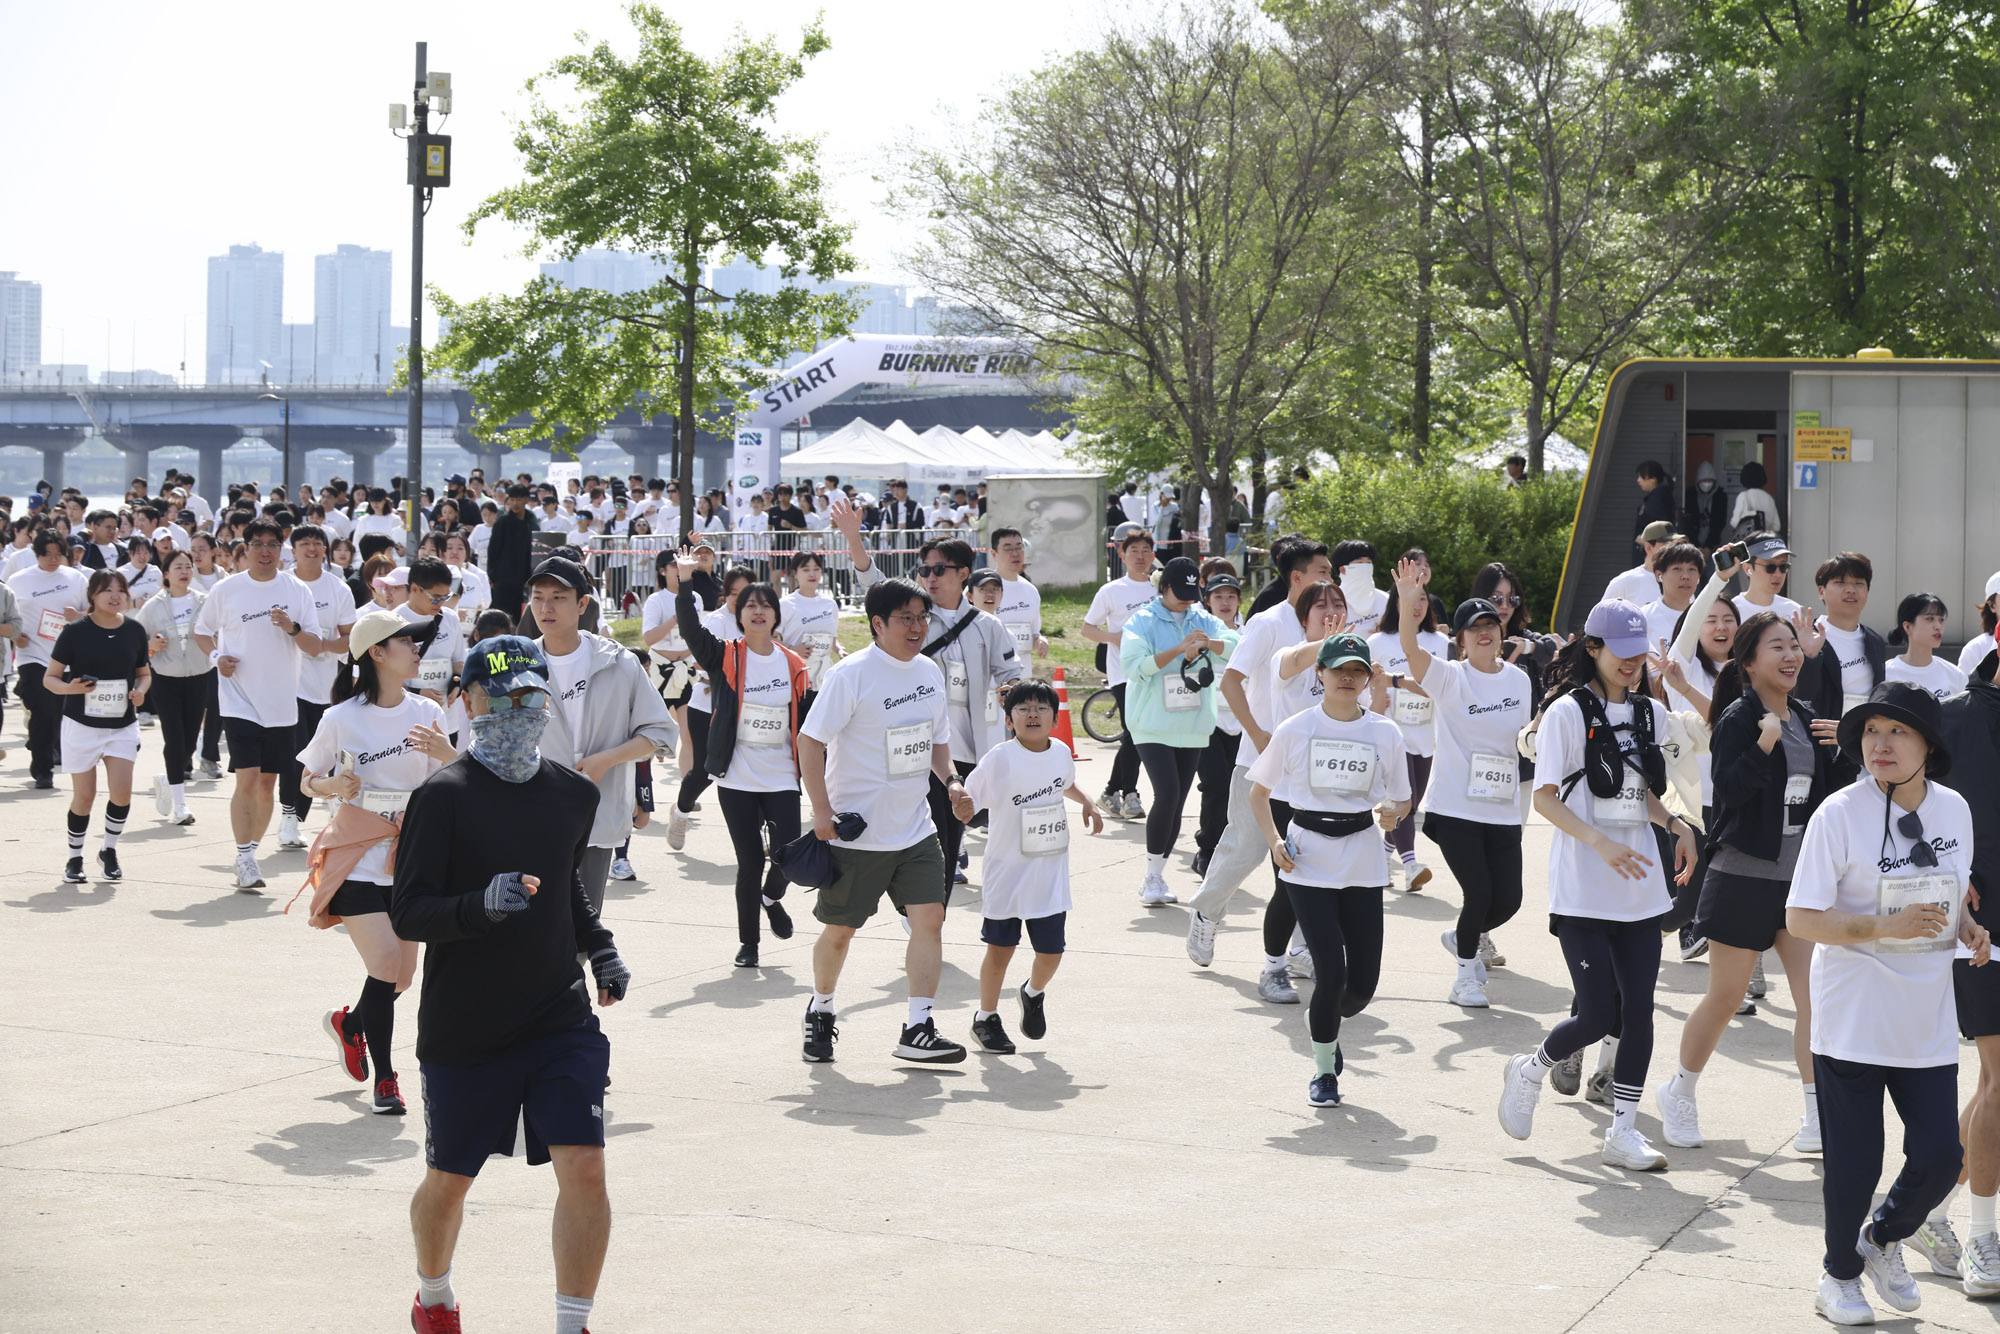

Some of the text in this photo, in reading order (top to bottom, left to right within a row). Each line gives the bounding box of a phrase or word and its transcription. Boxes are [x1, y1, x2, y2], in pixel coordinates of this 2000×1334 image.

[878, 353, 979, 374] BURNING
[763, 357, 837, 413] START
[32, 584, 69, 598] Burning Run
[315, 601, 329, 609] Run
[996, 604, 1018, 615] Burning
[241, 609, 271, 623] Burning
[801, 615, 823, 625] Burning
[1363, 612, 1379, 621] Run
[50, 621, 64, 630] 187
[436, 632, 449, 640] Run
[1015, 633, 1030, 641] 123
[815, 641, 830, 650] 285
[487, 651, 509, 675] M
[423, 670, 447, 681] 5041
[744, 678, 789, 693] urning Run
[98, 693, 124, 702] 6019
[883, 685, 935, 710] Burning Run
[1934, 689, 1951, 698] Run
[1407, 701, 1430, 710] 6424
[1468, 697, 1520, 715] Burning Run
[752, 719, 783, 730] 6253
[894, 739, 931, 756] M 5096
[358, 744, 403, 765] Burning
[1315, 758, 1368, 773] W 6163
[1475, 770, 1512, 784] W 6315
[1012, 785, 1053, 806] Burning
[1028, 826, 1036, 835] M
[1878, 855, 1914, 873] Burn
[1930, 836, 1959, 855] Run
[1887, 880, 1931, 890] BURNING RUN
